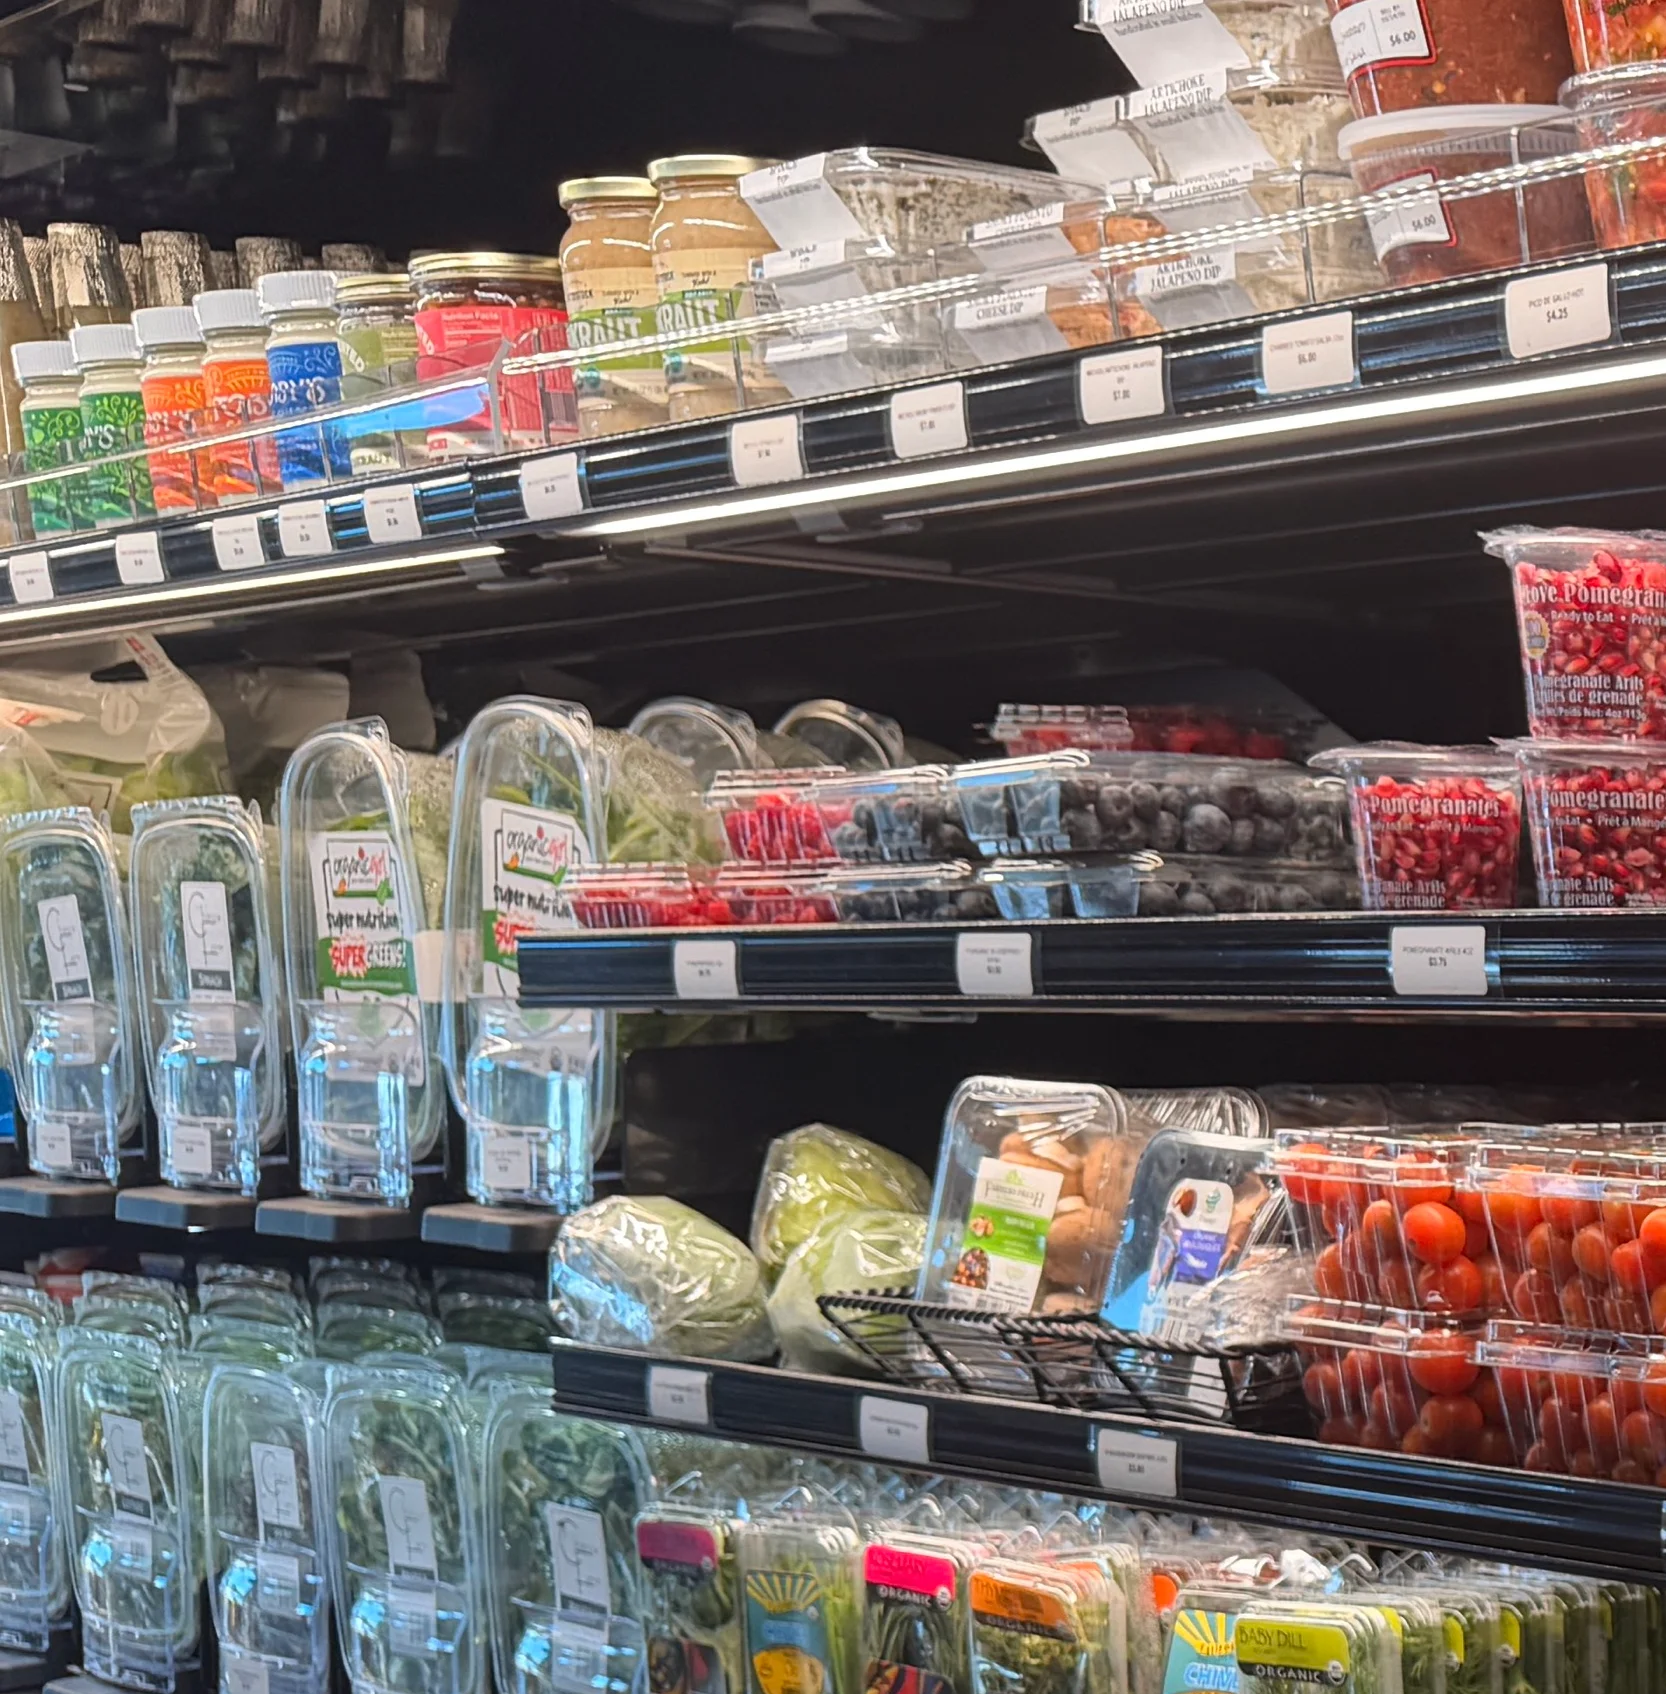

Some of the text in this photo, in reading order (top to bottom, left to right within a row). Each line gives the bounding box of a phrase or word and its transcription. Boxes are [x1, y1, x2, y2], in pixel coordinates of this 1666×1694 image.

[1389, 29, 1416, 47] $6.00
[1201, 264, 1221, 282] DIP
[1547, 307, 1568, 323] $4.25
[1597, 610, 1614, 623] Eat
[1568, 689, 1643, 707] de grenade
[876, 1584, 934, 1609] ORGANIC
[1238, 1626, 1307, 1651] BABY DILL
[1255, 1664, 1321, 1683] ORGANIC
